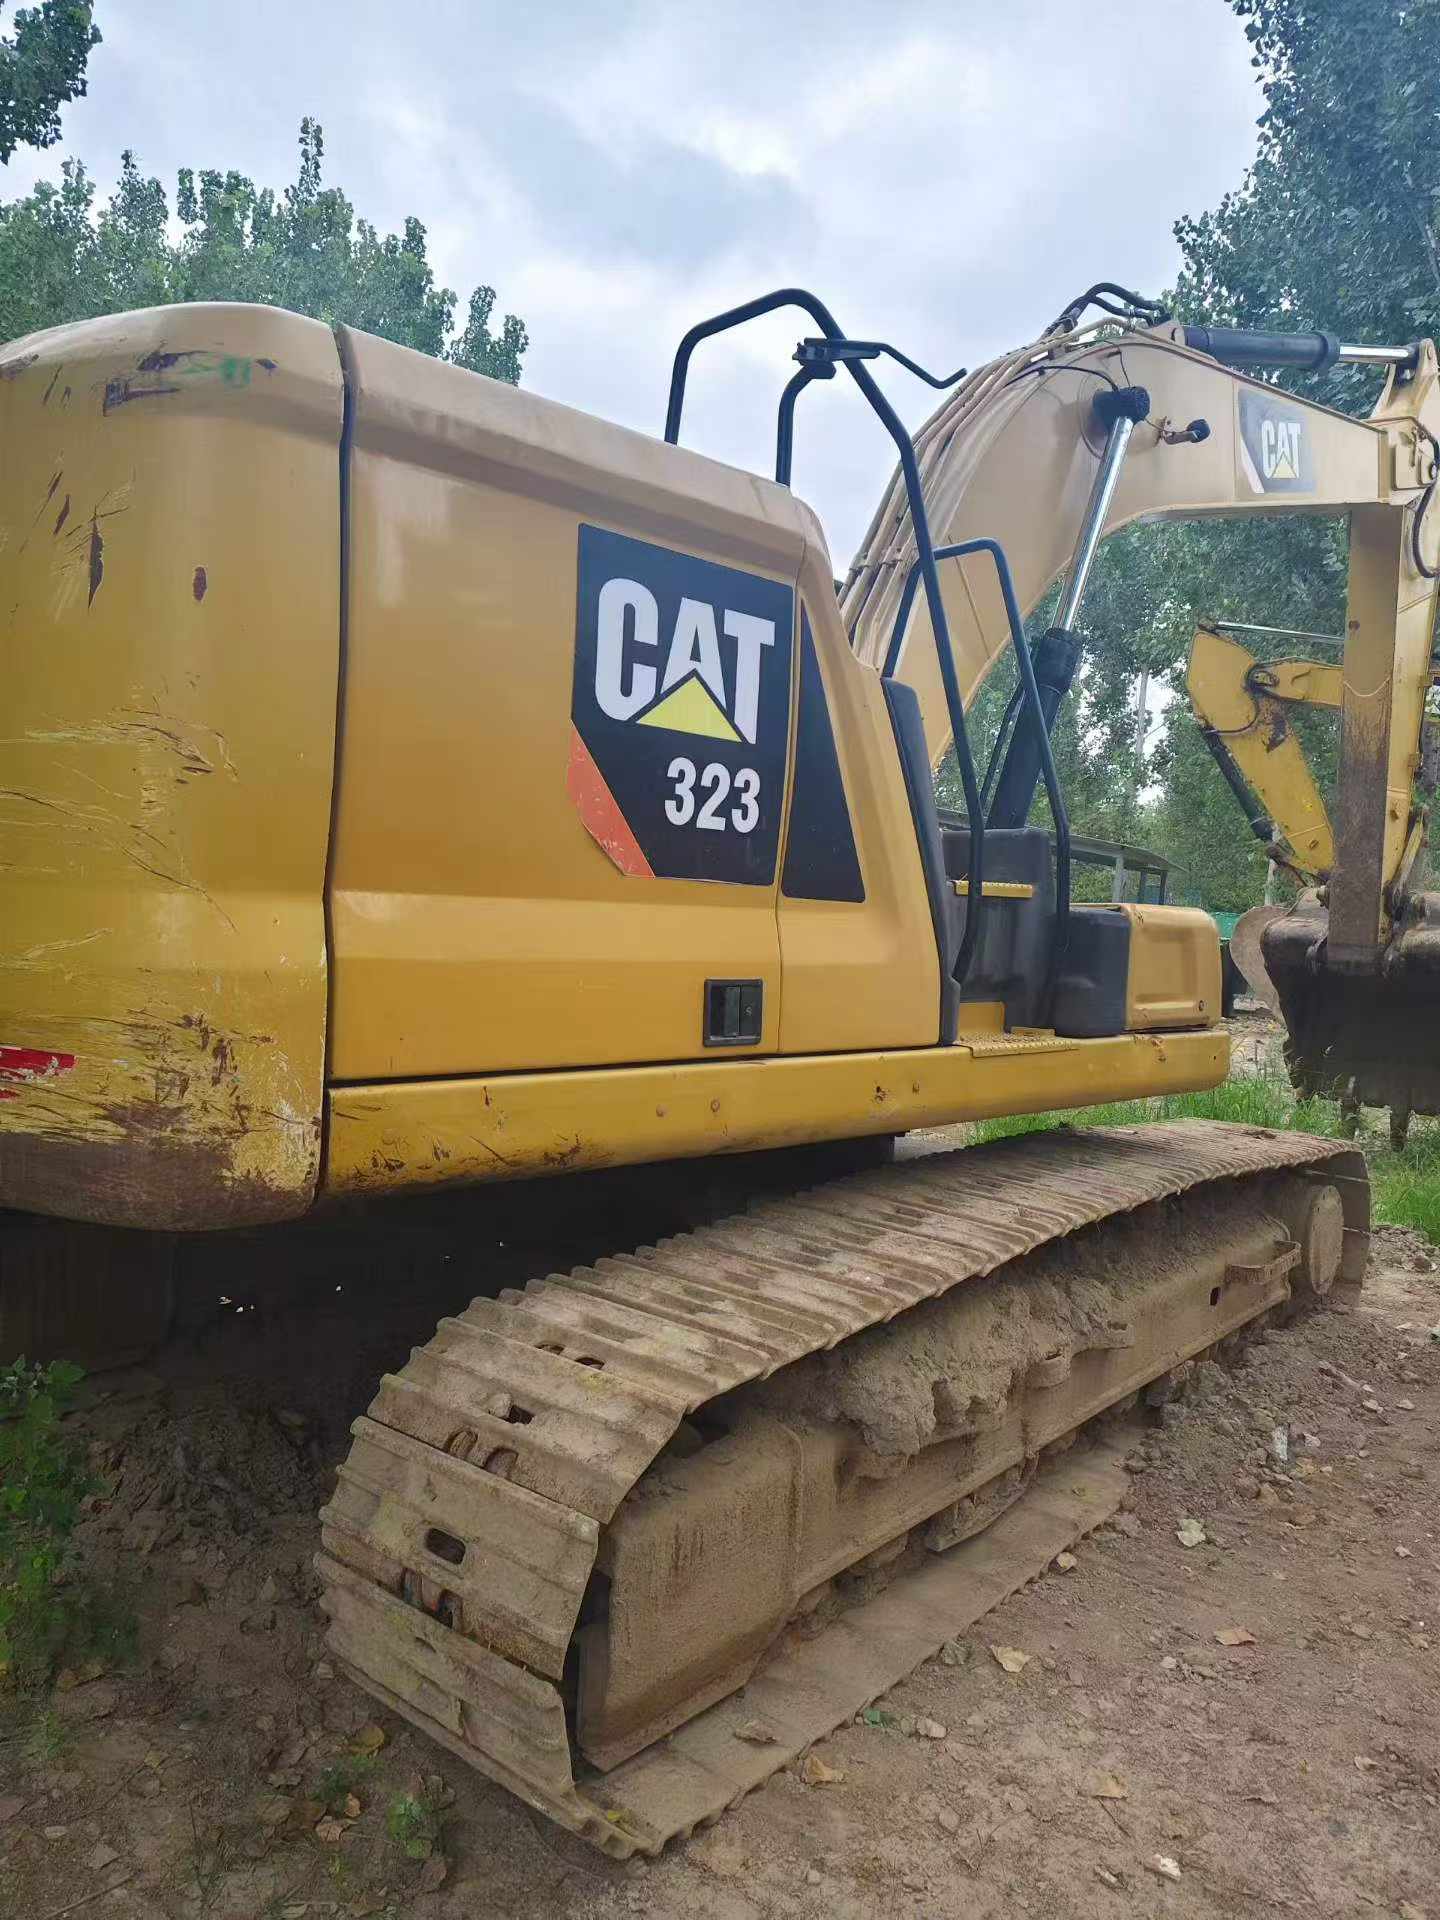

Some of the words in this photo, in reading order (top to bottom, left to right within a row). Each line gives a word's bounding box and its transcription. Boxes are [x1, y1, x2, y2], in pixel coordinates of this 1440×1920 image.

[1261, 420, 1301, 478] CAT
[594, 577, 776, 745] CAT
[664, 756, 761, 834] 323
